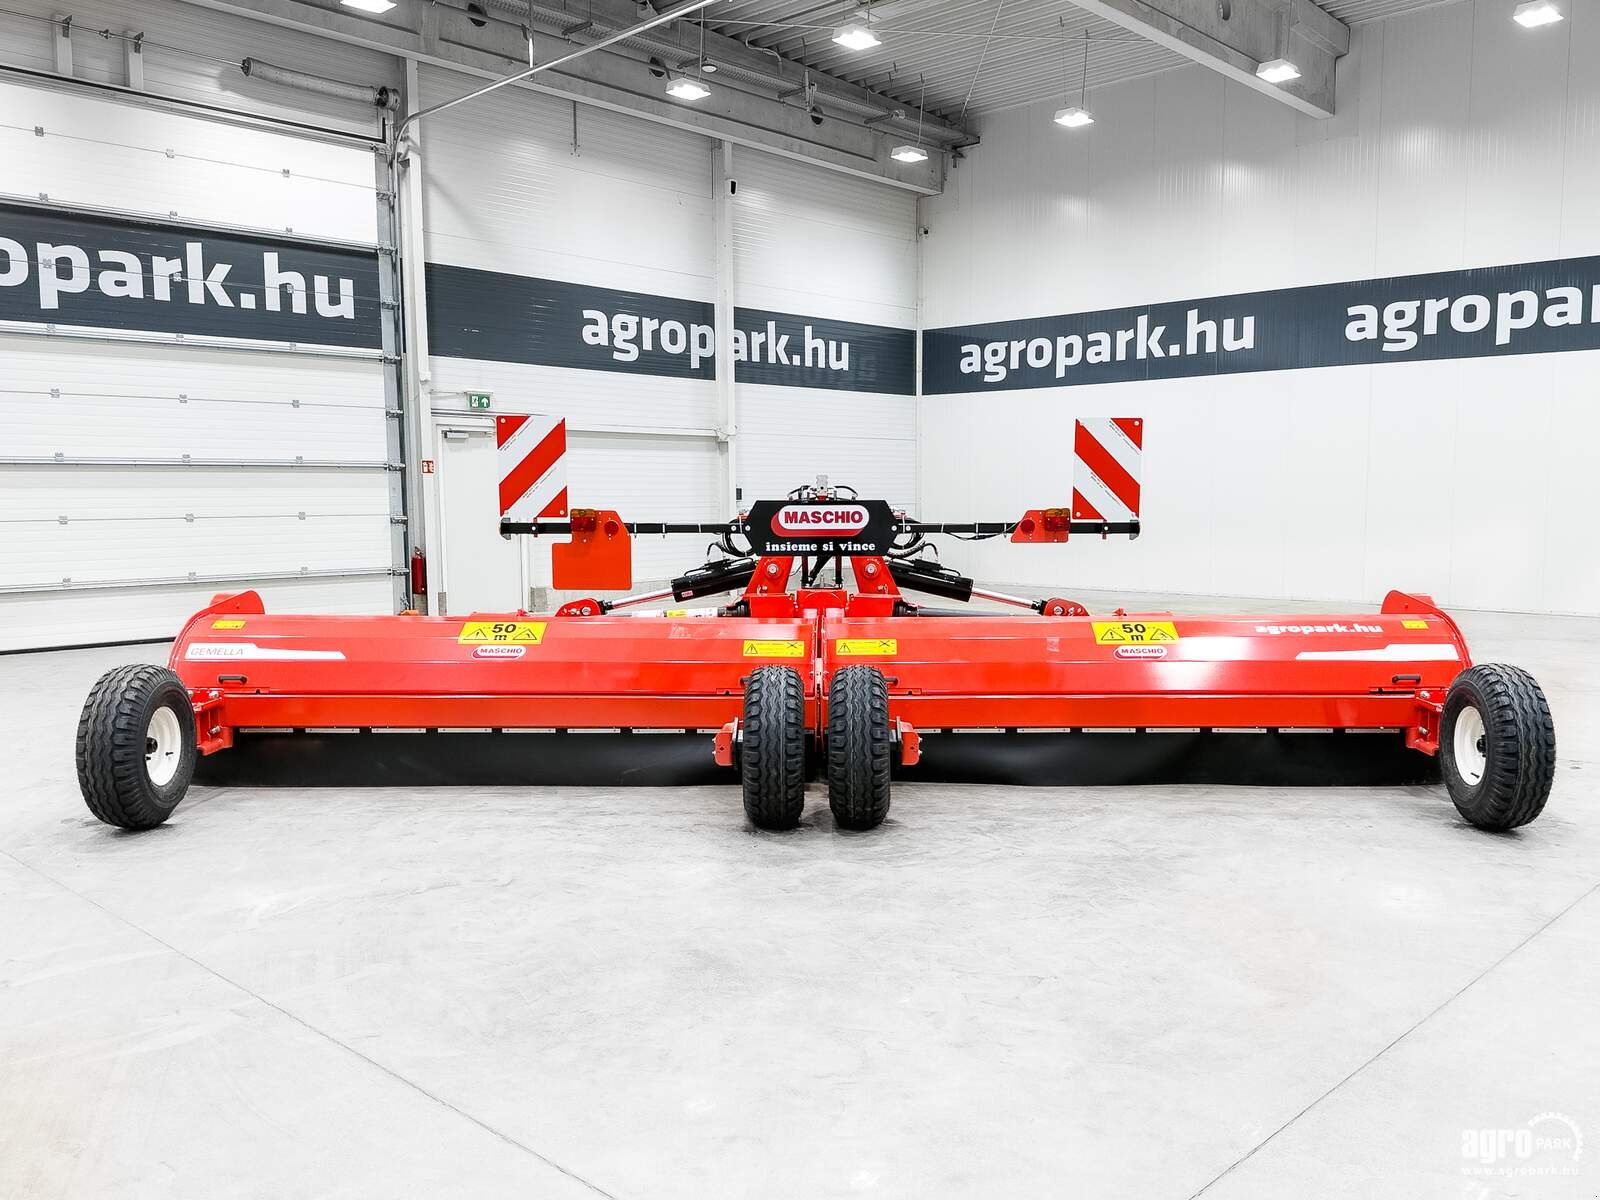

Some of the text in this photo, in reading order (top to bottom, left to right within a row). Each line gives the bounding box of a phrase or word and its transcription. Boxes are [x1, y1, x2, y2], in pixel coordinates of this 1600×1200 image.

[960, 308, 1255, 383] agropark.hu
[784, 511, 863, 523] MASCHIO
[765, 541, 875, 551] insieme si vince
[492, 624, 516, 633] 50
[1122, 624, 1146, 633] 50
[1255, 623, 1383, 634] agropark.hu
